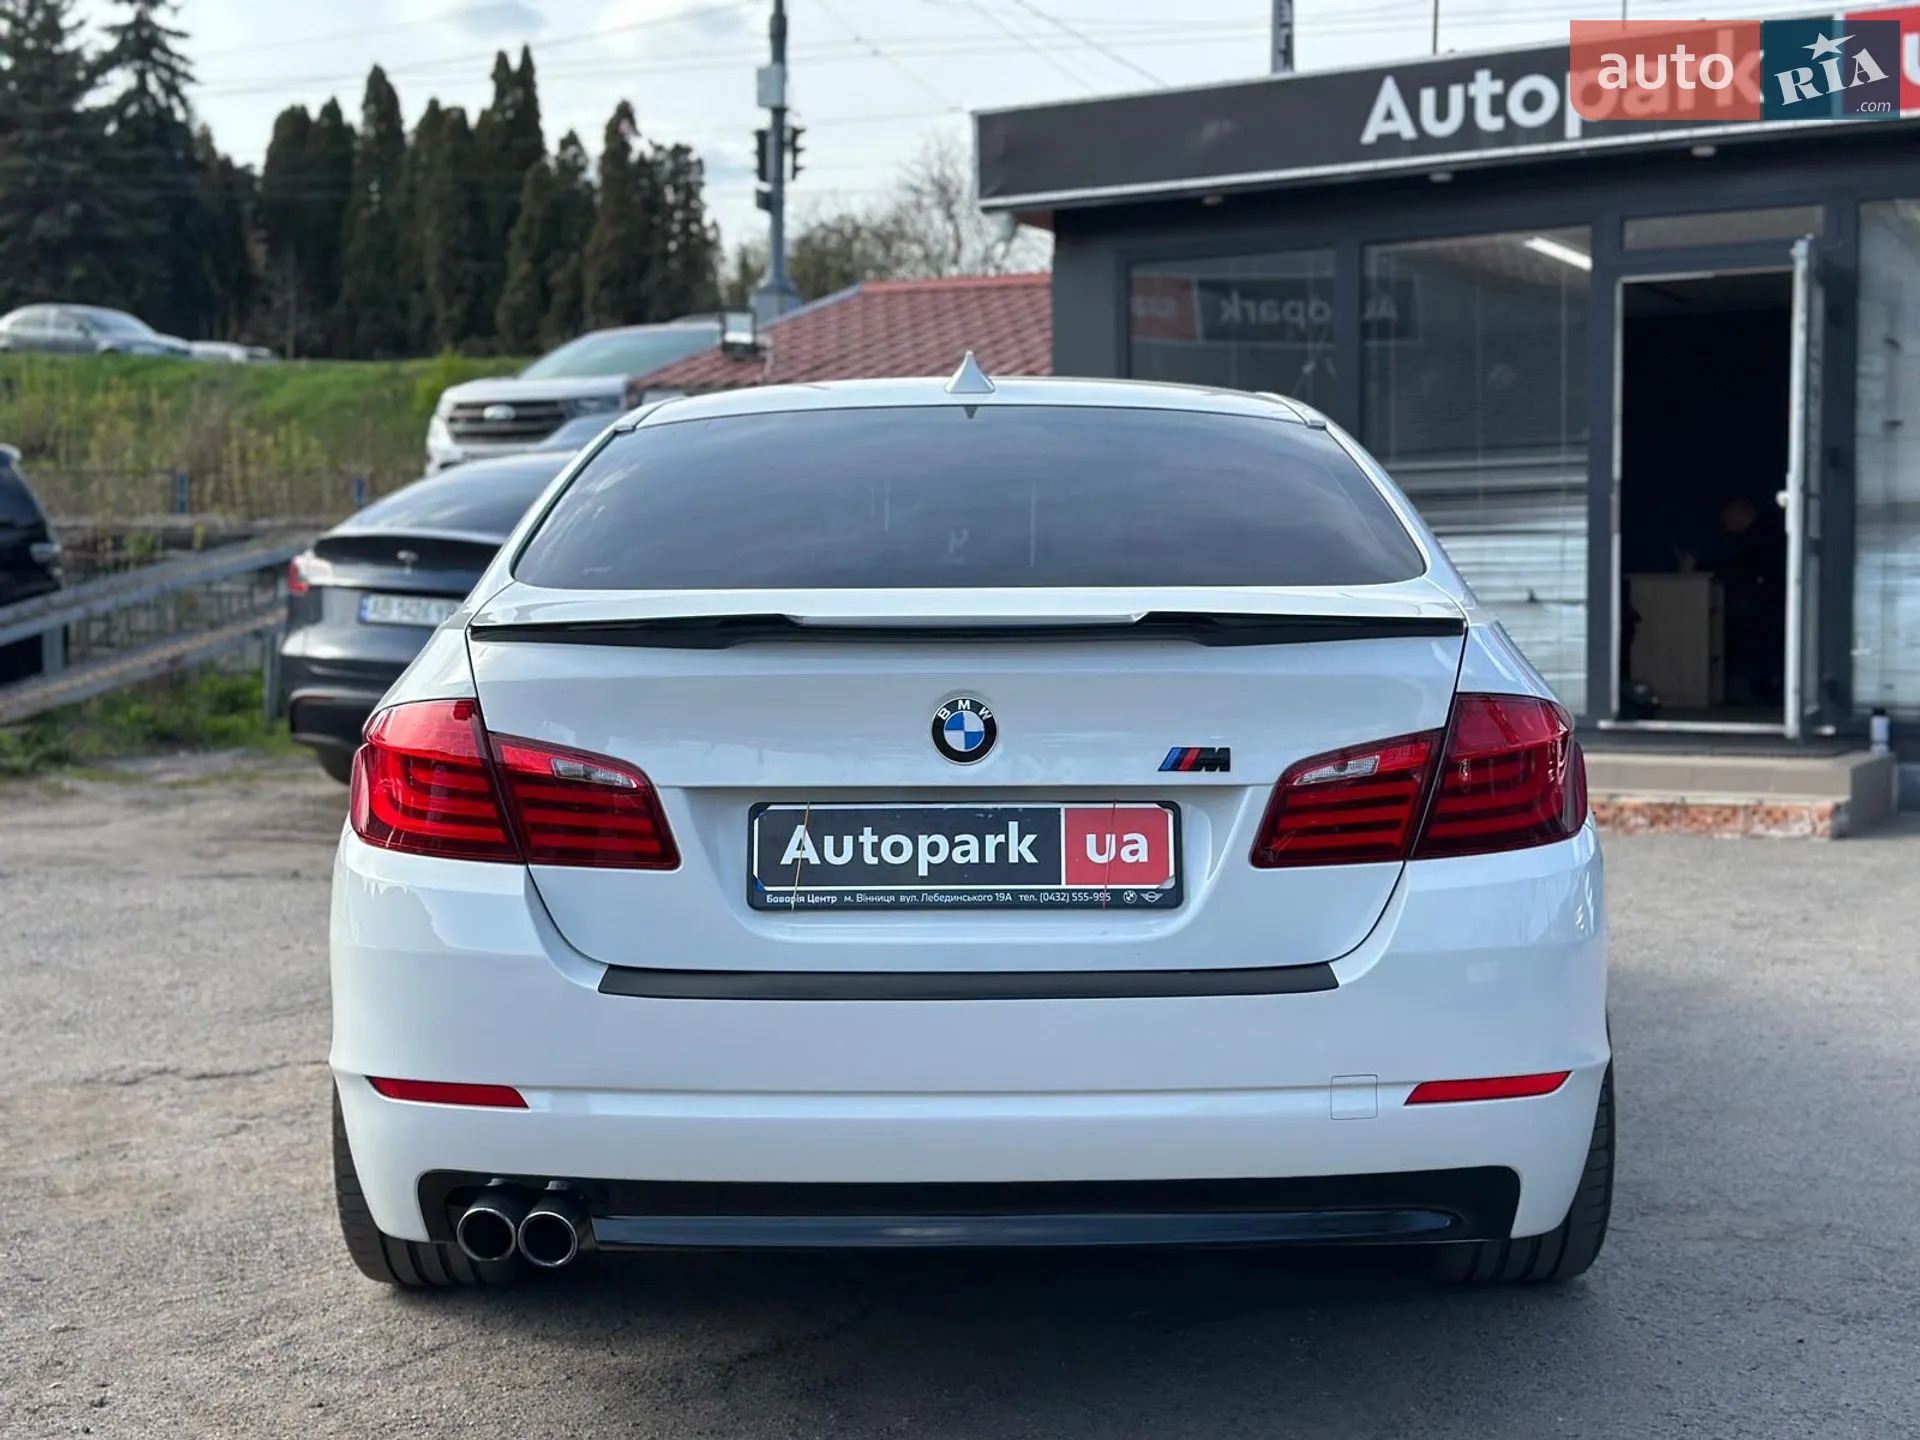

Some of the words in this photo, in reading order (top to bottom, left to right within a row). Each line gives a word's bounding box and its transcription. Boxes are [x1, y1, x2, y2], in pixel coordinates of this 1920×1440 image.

[937, 699, 992, 720] BMW
[780, 820, 1038, 877] Autopark
[1085, 831, 1149, 864] ua
[807, 893, 838, 905] Центр
[856, 893, 895, 904] Вінниця
[920, 893, 993, 904] Лебединського
[1039, 892, 1070, 904] (0432)
